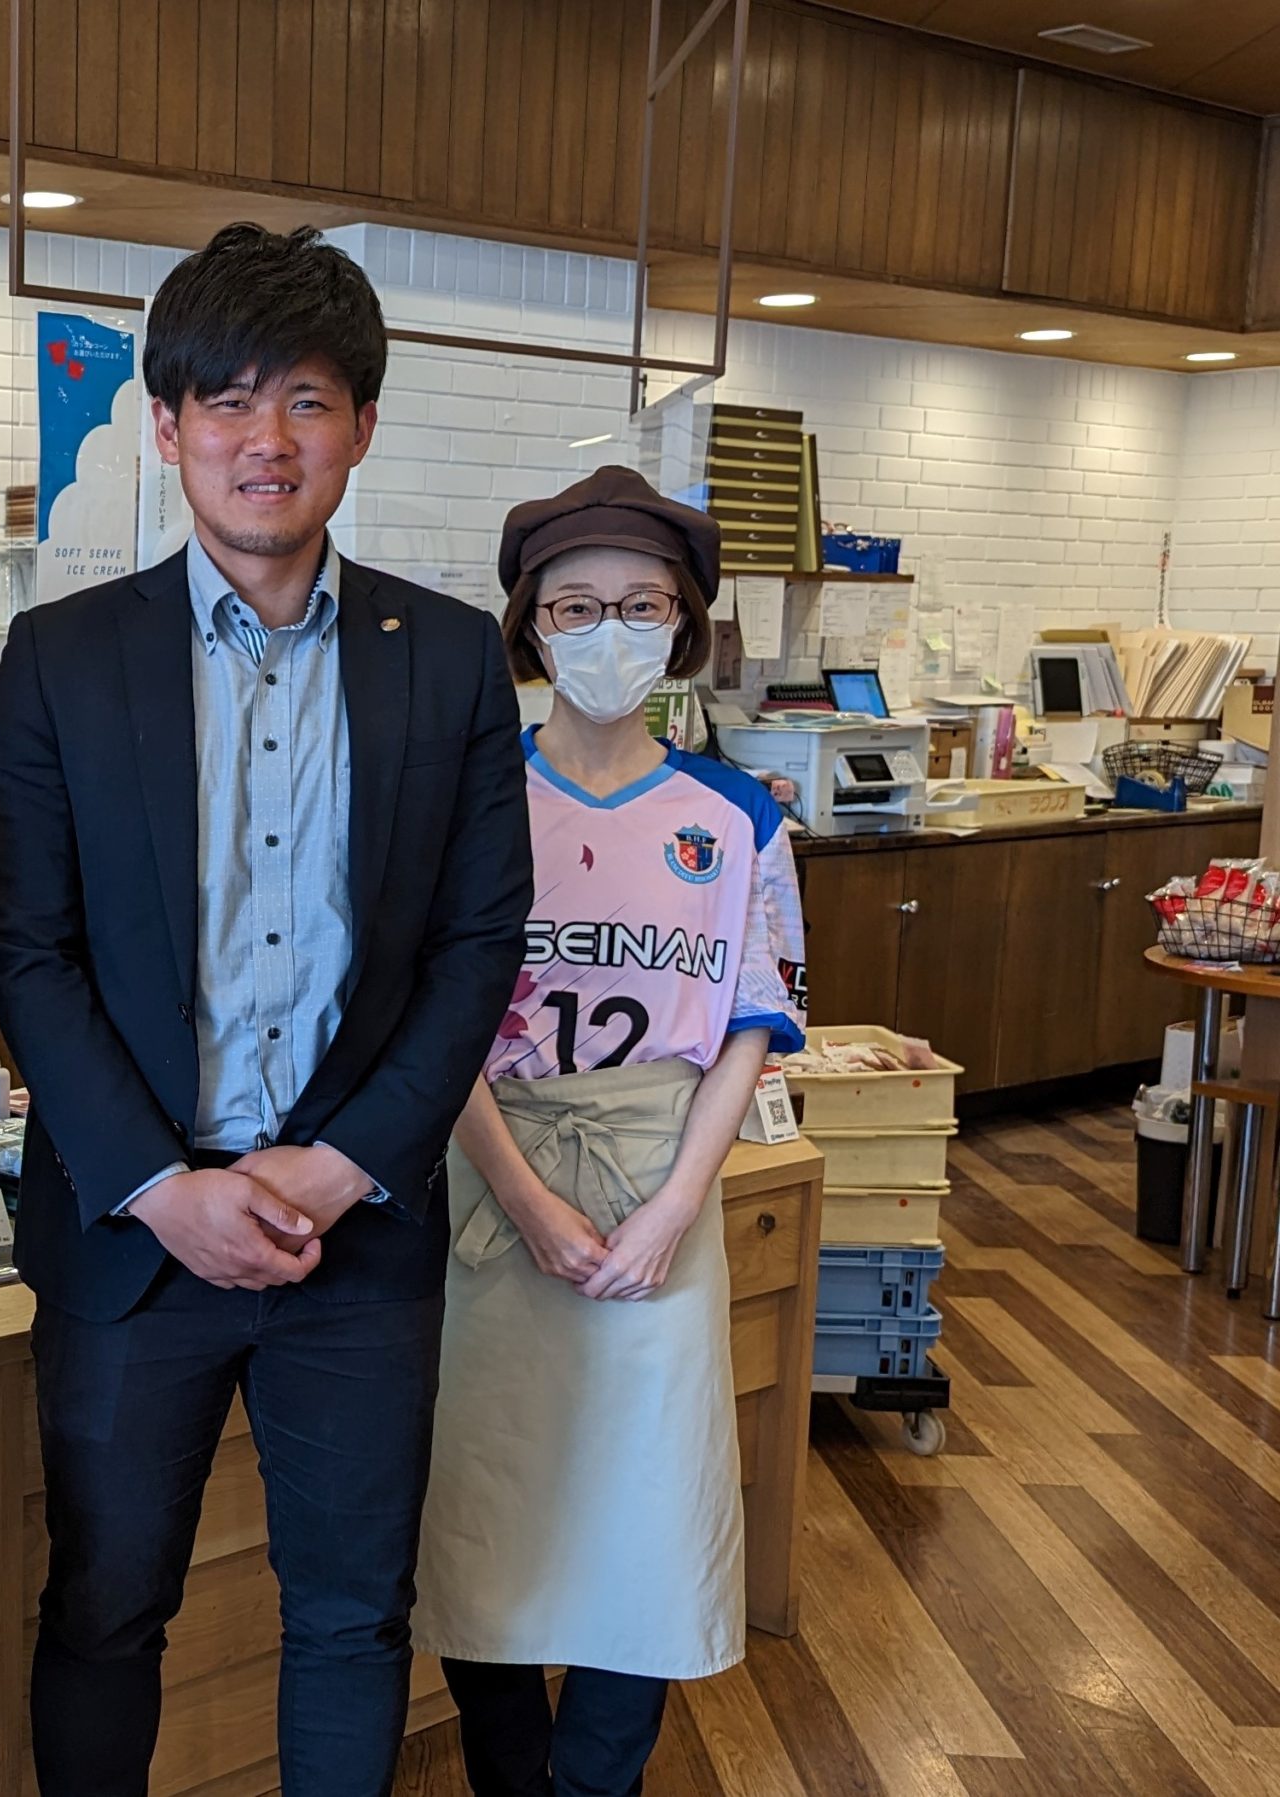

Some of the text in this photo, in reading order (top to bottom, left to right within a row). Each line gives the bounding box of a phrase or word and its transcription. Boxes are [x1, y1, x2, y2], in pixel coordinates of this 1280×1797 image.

[55, 548, 122, 559] SOFT SERVE
[66, 565, 126, 576] ICE CREAM
[541, 990, 650, 1075] 12
